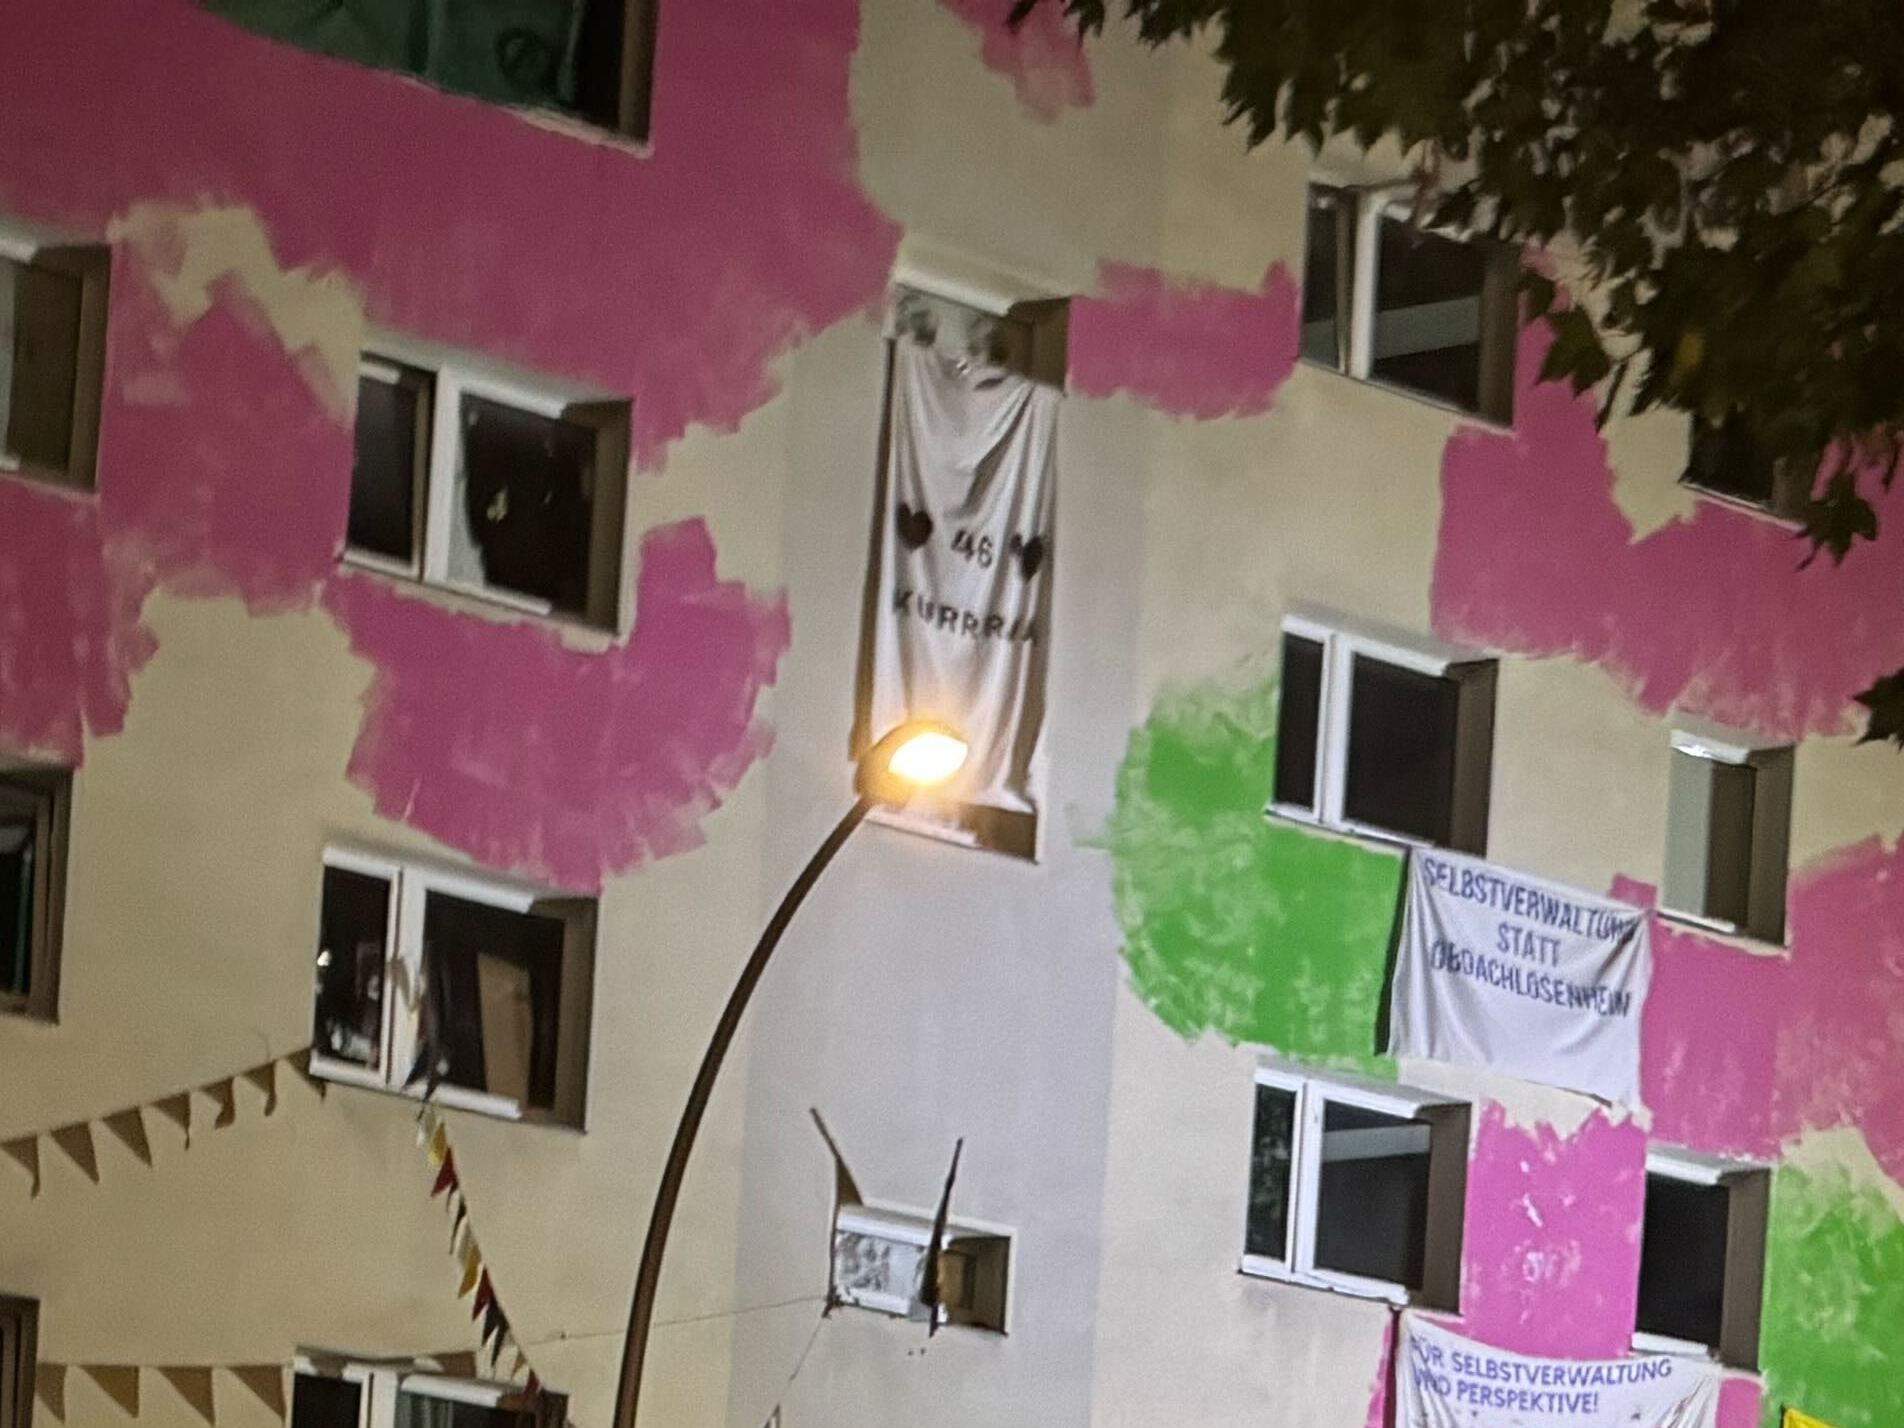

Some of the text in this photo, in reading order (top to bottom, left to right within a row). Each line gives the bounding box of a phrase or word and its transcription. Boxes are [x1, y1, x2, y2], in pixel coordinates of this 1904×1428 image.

[951, 529, 994, 570] 46
[1424, 858, 1639, 943] SELBSTVERWALTUN
[1497, 922, 1561, 968] STATT
[1451, 1351, 1673, 1387] SELBSTVERWALTUNG
[1457, 1379, 1600, 1414] PERSPEKTIVE!
